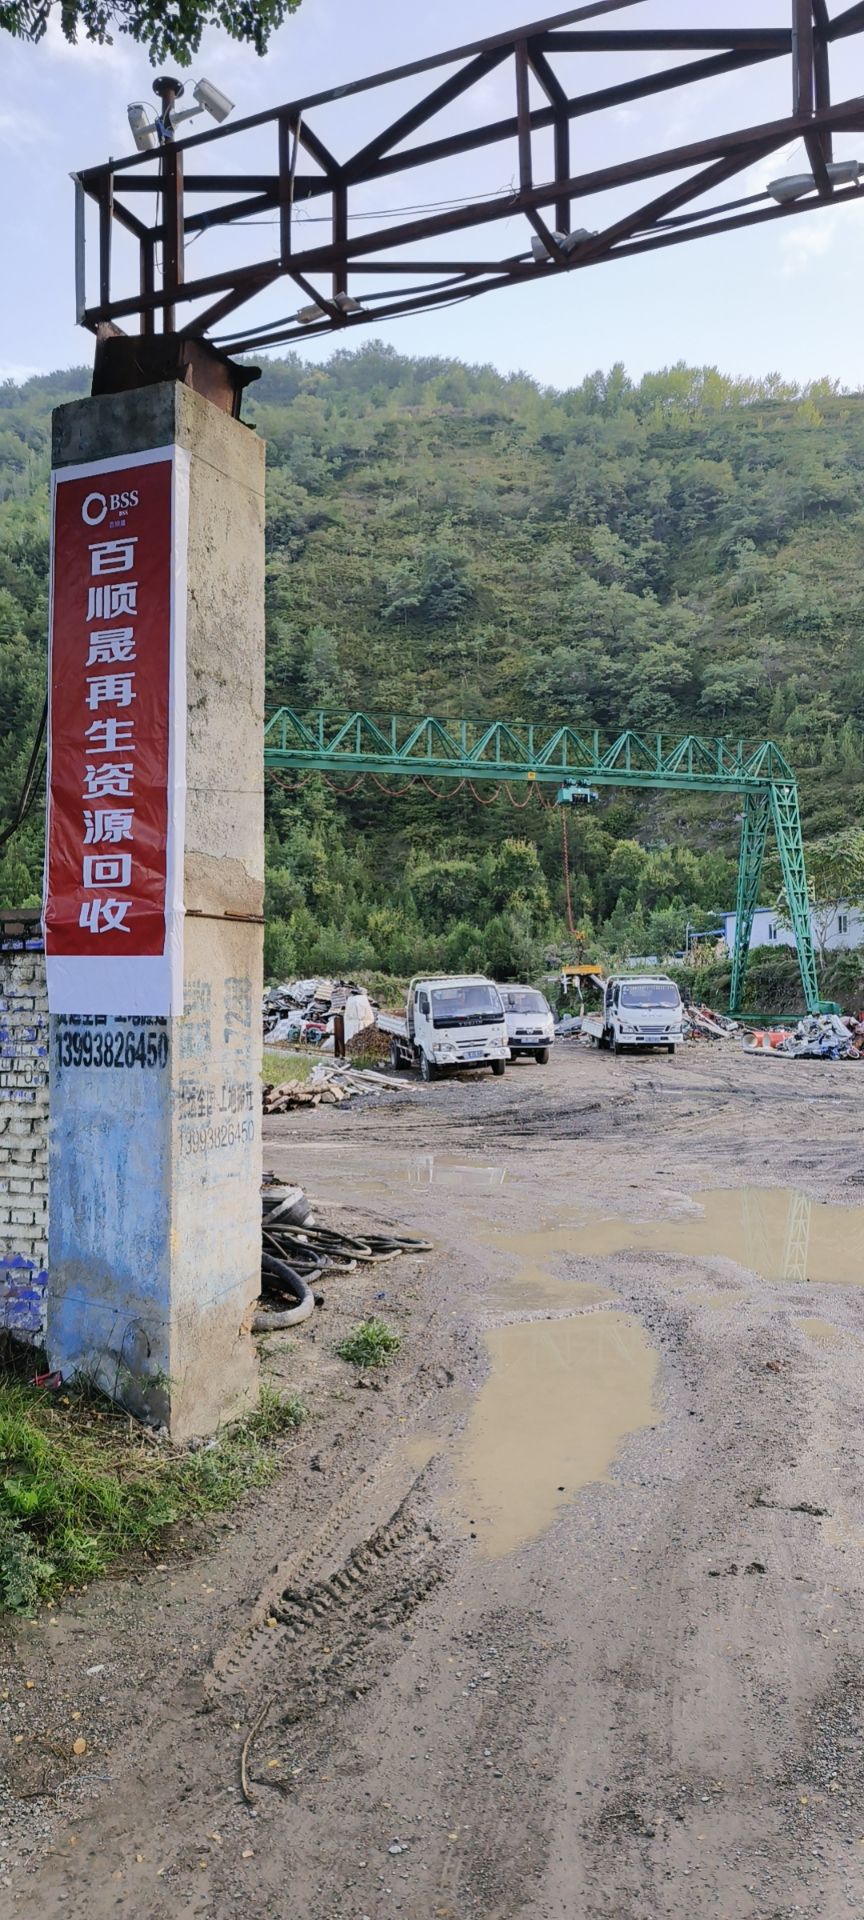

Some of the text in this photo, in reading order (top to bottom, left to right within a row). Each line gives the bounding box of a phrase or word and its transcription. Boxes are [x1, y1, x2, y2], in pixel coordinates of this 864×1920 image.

[110, 490, 139, 511] BSS
[79, 536, 139, 935] 百顺晟再生资源回收
[55, 1030, 169, 1069] 13993826450
[179, 1119, 254, 1156] 13993826450
